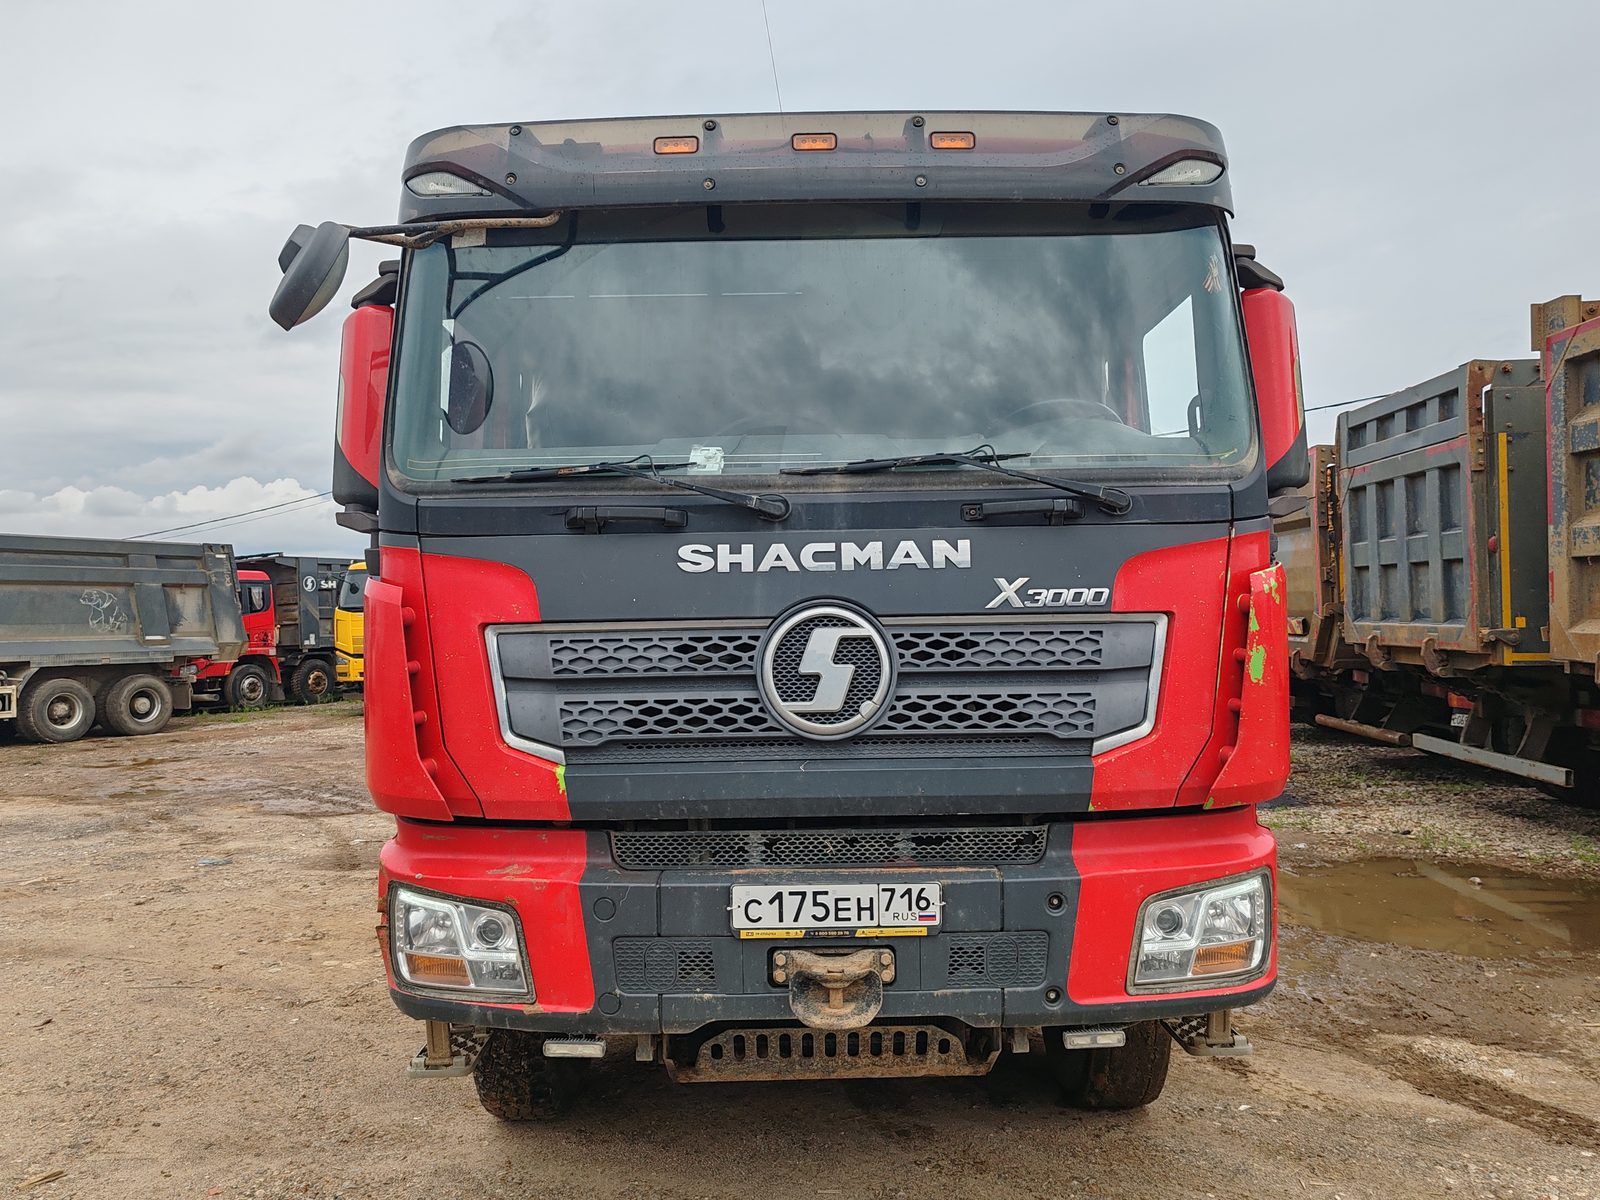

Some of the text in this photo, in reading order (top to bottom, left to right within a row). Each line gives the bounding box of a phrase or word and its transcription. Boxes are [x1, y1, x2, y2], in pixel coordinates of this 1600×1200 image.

[677, 539, 972, 573] SHACMAN
[985, 577, 1110, 608] X3000
[881, 887, 931, 912] 716
[892, 912, 918, 921] RUS
